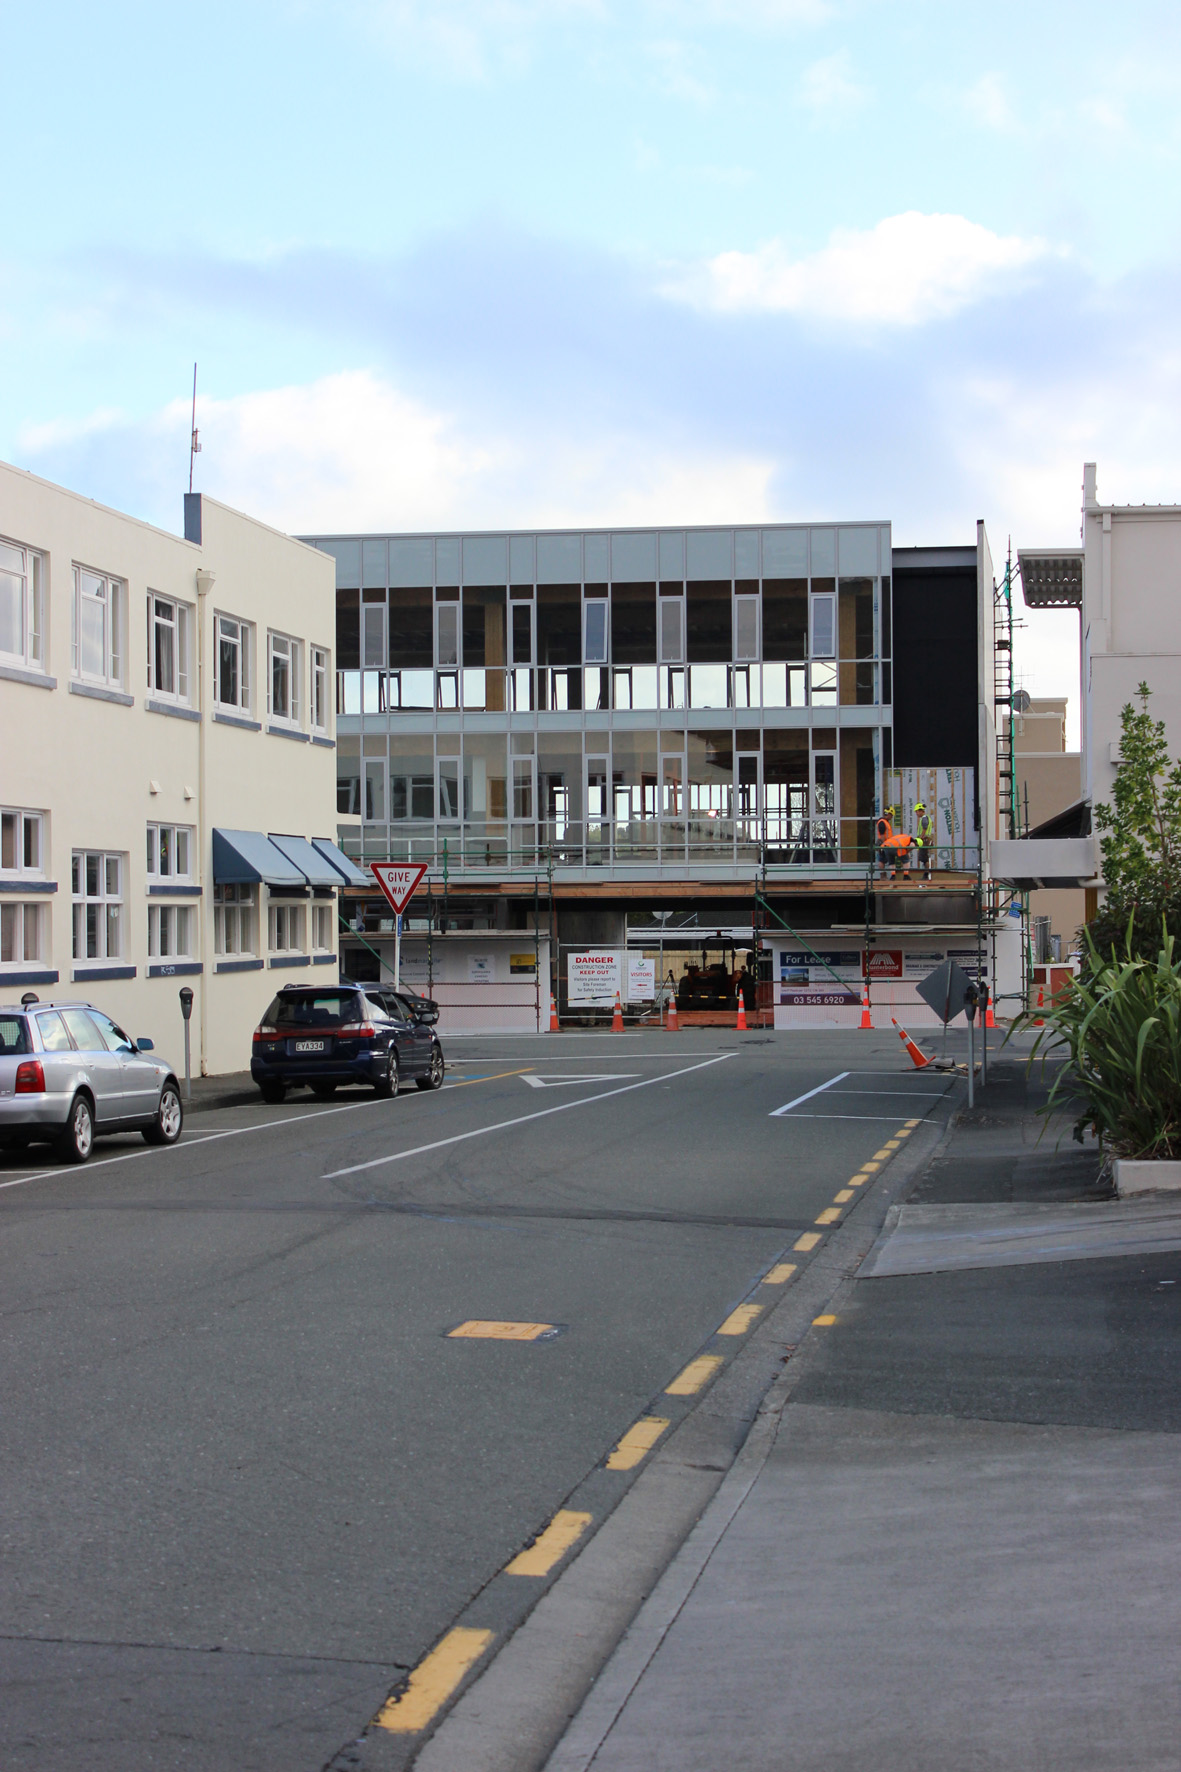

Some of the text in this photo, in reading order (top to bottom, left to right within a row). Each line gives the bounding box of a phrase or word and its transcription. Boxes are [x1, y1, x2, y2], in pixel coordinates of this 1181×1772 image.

[388, 872, 410, 882] GIVE
[786, 955, 801, 964] For
[297, 1042, 323, 1050] EYA334
